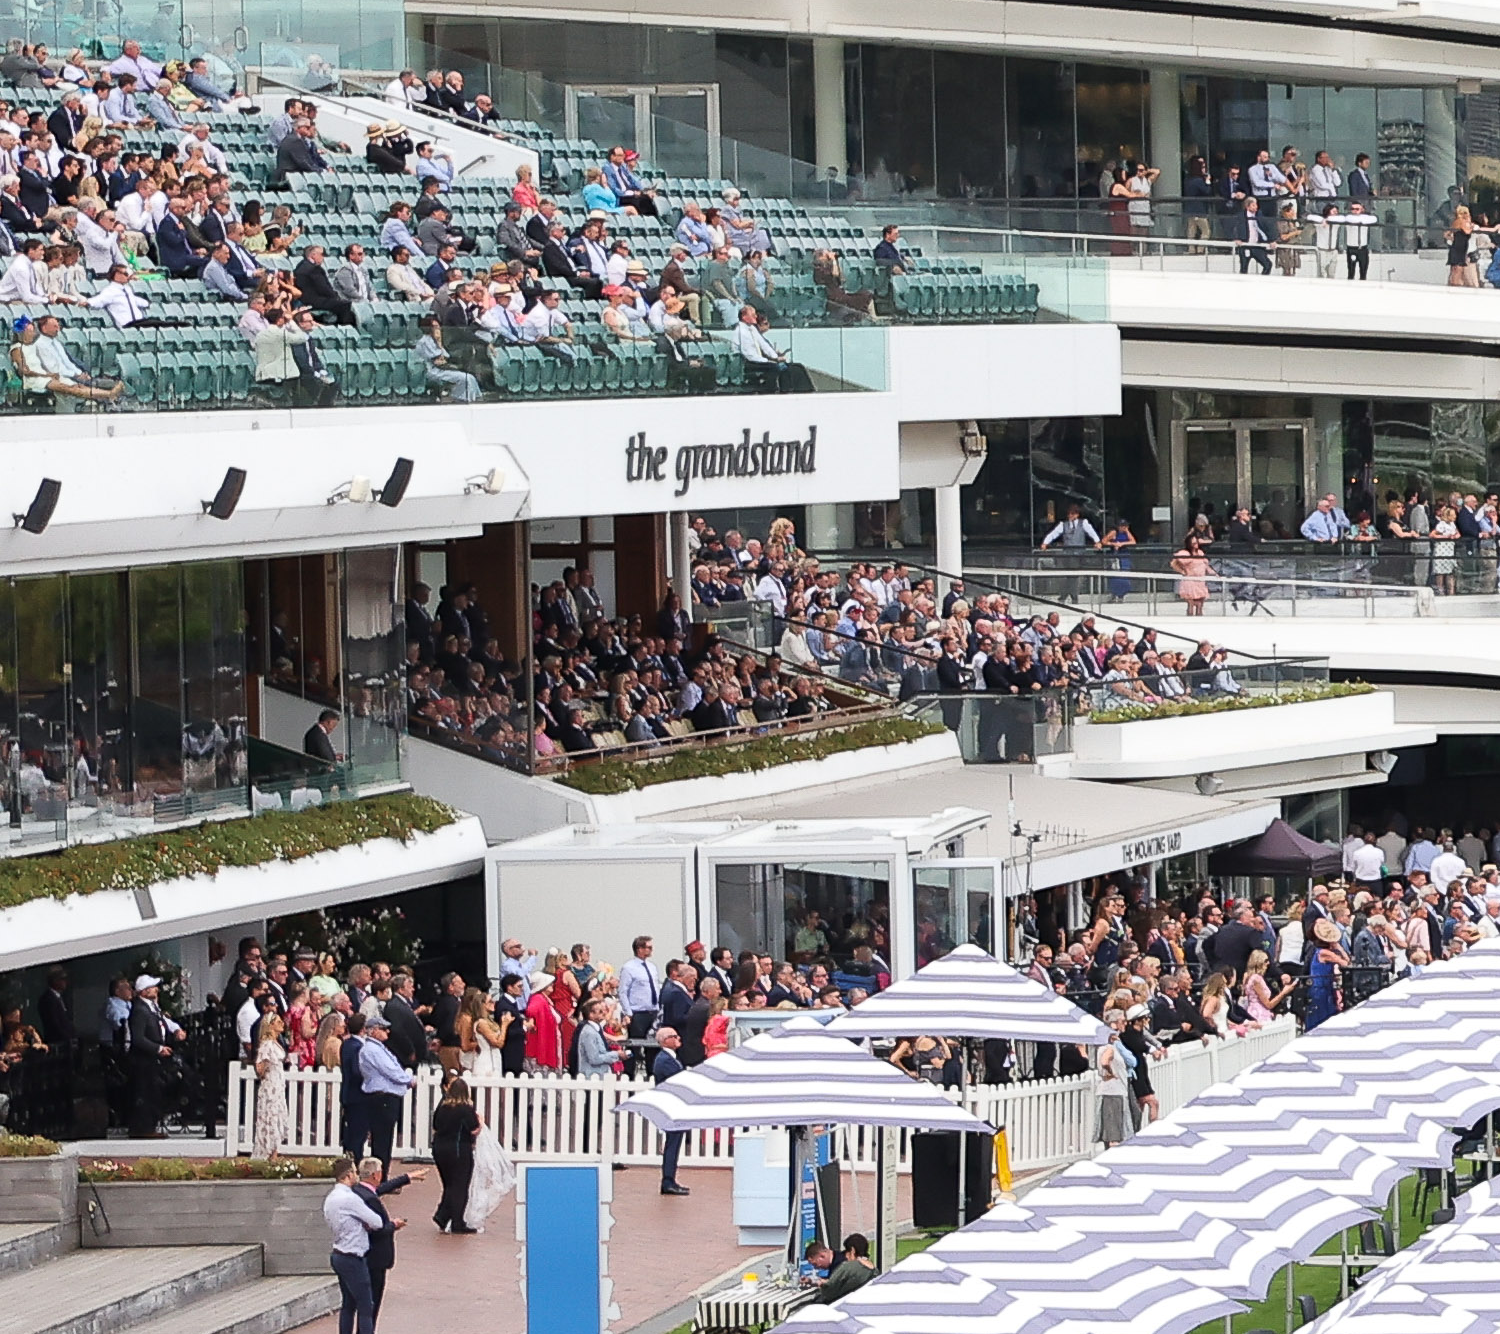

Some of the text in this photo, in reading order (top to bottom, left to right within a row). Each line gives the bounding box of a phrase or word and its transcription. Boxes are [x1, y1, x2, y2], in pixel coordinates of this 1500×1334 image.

[625, 424, 818, 498] the grandstand
[1122, 831, 1182, 865] THE MOUNTING YARD
